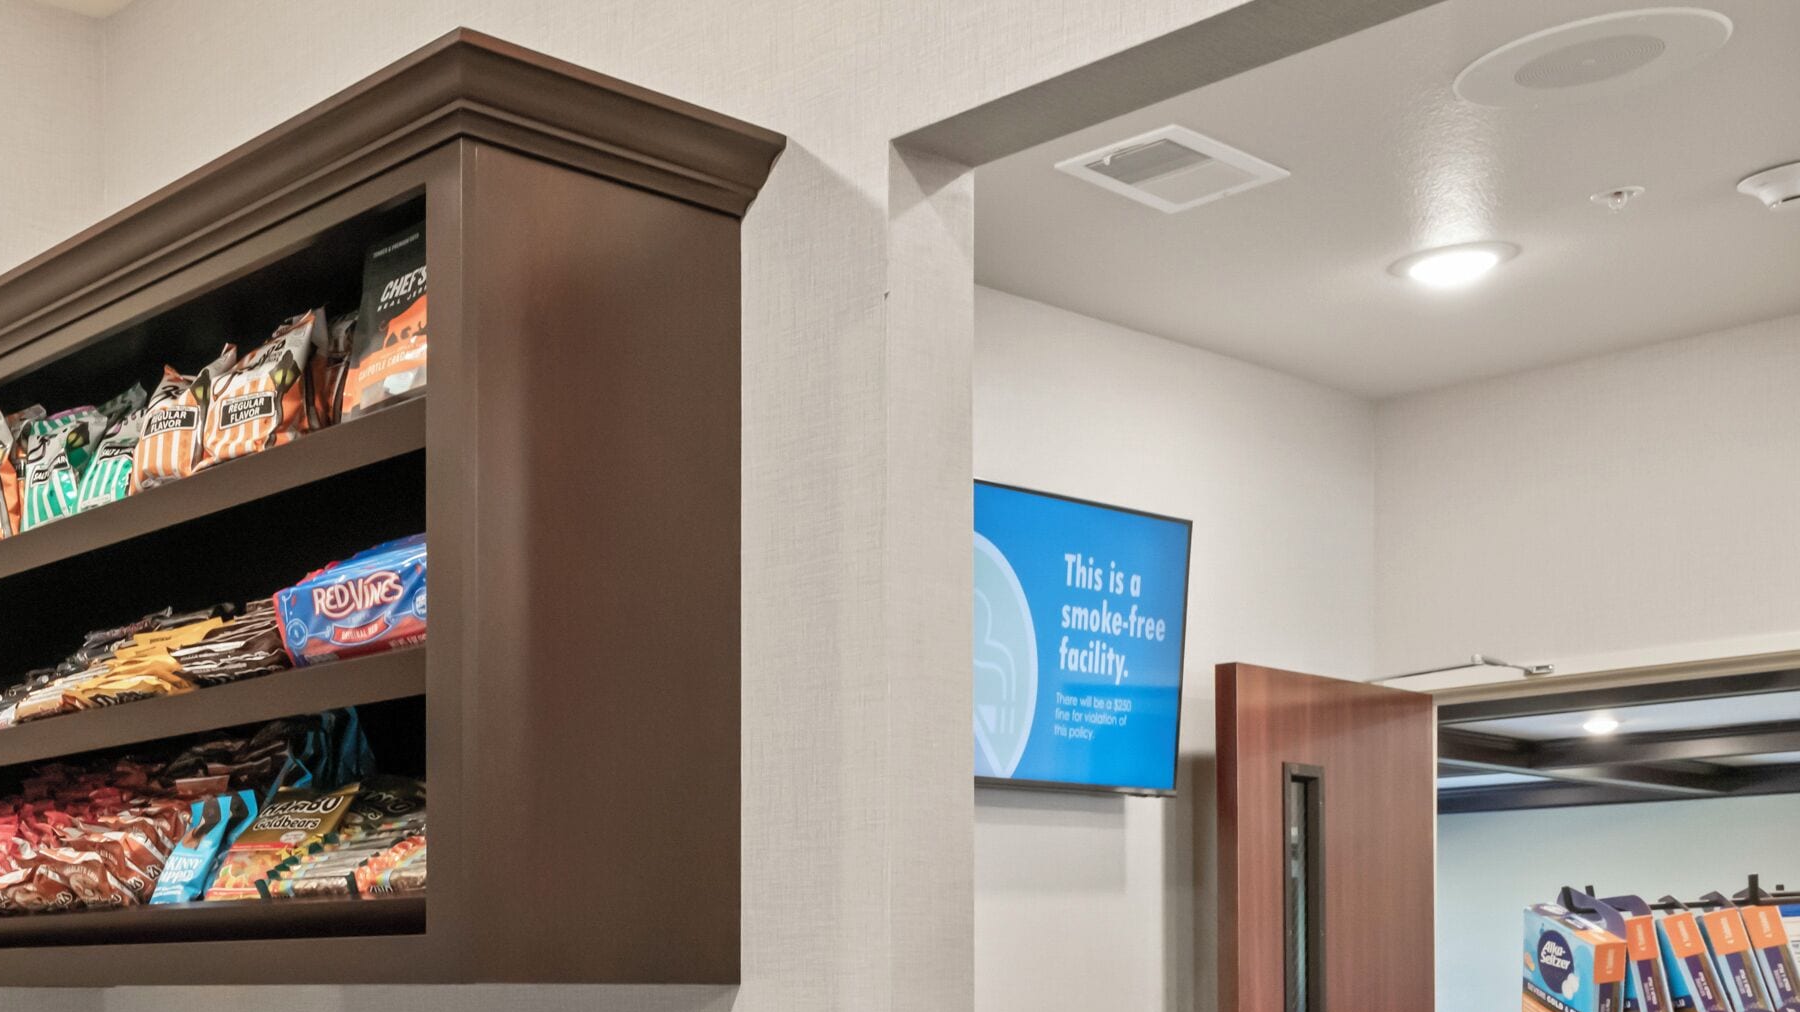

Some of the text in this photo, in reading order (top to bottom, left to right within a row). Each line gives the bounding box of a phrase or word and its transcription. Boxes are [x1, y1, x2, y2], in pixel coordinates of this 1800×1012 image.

[228, 398, 264, 413] REGULAR
[230, 407, 260, 423] FLAVOR
[151, 419, 182, 433] FLAVOR
[1064, 553, 1142, 598] This is a
[312, 582, 355, 619] RED
[1061, 599, 1166, 642] smoke-free
[1059, 635, 1129, 686] facility.
[1056, 691, 1078, 706] There
[1080, 695, 1092, 707] will
[1094, 696, 1104, 709] be
[1106, 700, 1113, 710] a
[1055, 707, 1128, 727] fine for violation of
[1054, 724, 1067, 736] this
[253, 816, 321, 831] Goldbears
[1543, 940, 1567, 957] Alka-
[1540, 950, 1571, 970] Seltzer
